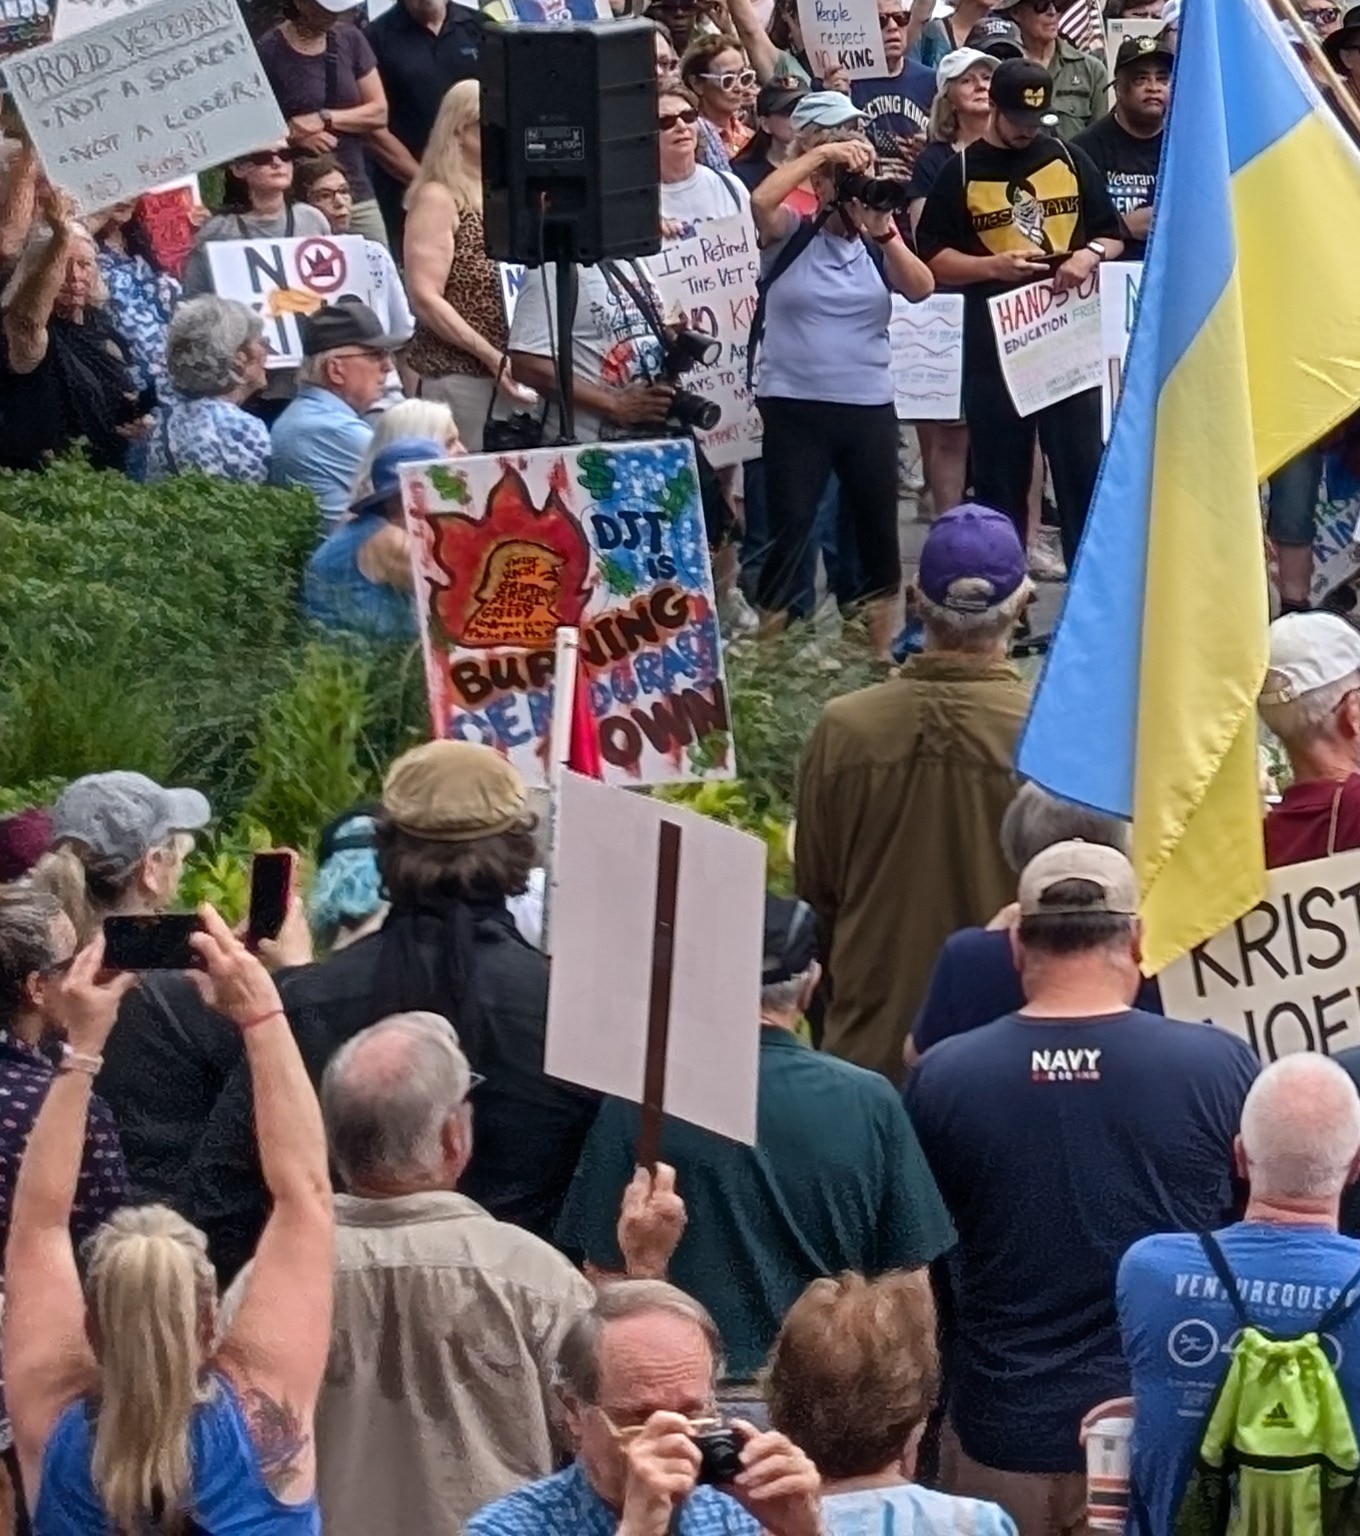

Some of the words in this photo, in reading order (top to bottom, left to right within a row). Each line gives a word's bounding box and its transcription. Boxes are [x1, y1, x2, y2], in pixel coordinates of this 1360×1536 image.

[820, 25, 867, 50] respect
[838, 47, 875, 70] KING
[16, 43, 112, 99] PROUD
[53, 88, 109, 128] NOT
[121, 81, 139, 99] A
[136, 125, 153, 143] A
[165, 73, 265, 130] LOSER!
[657, 245, 698, 277] I'm
[700, 226, 749, 264] Retired
[719, 269, 743, 288] VET
[996, 285, 1070, 335] HANDS
[1004, 313, 1069, 356] EDUCATION
[590, 510, 666, 554] DJT
[1031, 1048, 1102, 1072] NAVY
